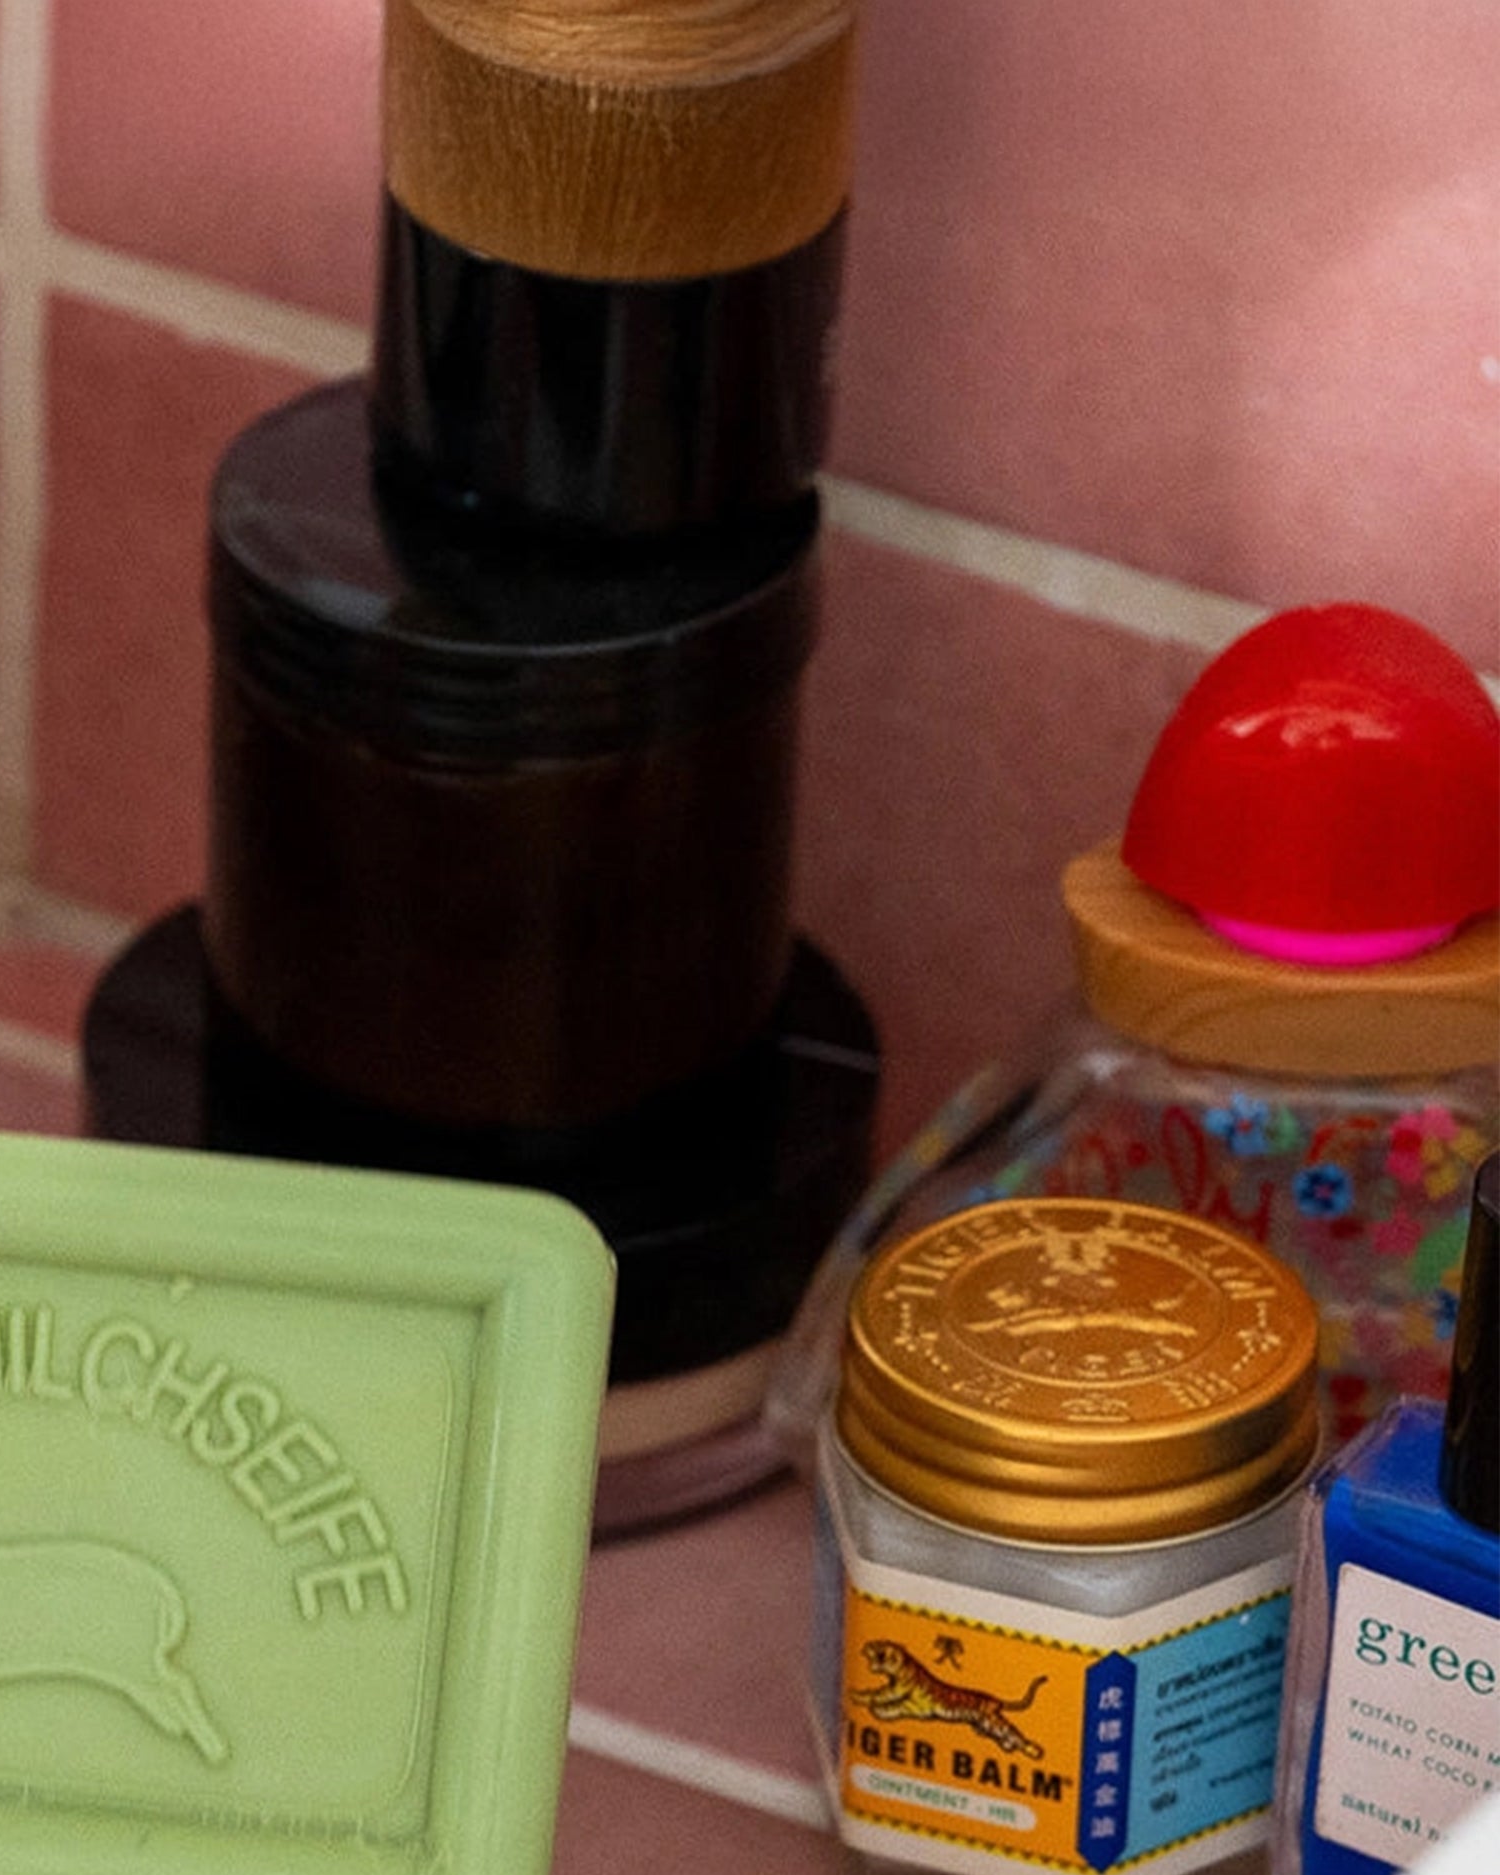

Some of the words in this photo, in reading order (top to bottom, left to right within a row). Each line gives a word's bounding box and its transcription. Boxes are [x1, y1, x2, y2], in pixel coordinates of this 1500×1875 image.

[846, 1719, 936, 1771] IGER
[1349, 1696, 1418, 1735] POTATO
[1425, 1726, 1480, 1759] CORN
[1346, 1726, 1413, 1762] WHEAT
[1421, 1755, 1478, 1789] COCO
[1340, 1792, 1421, 1835] natural
